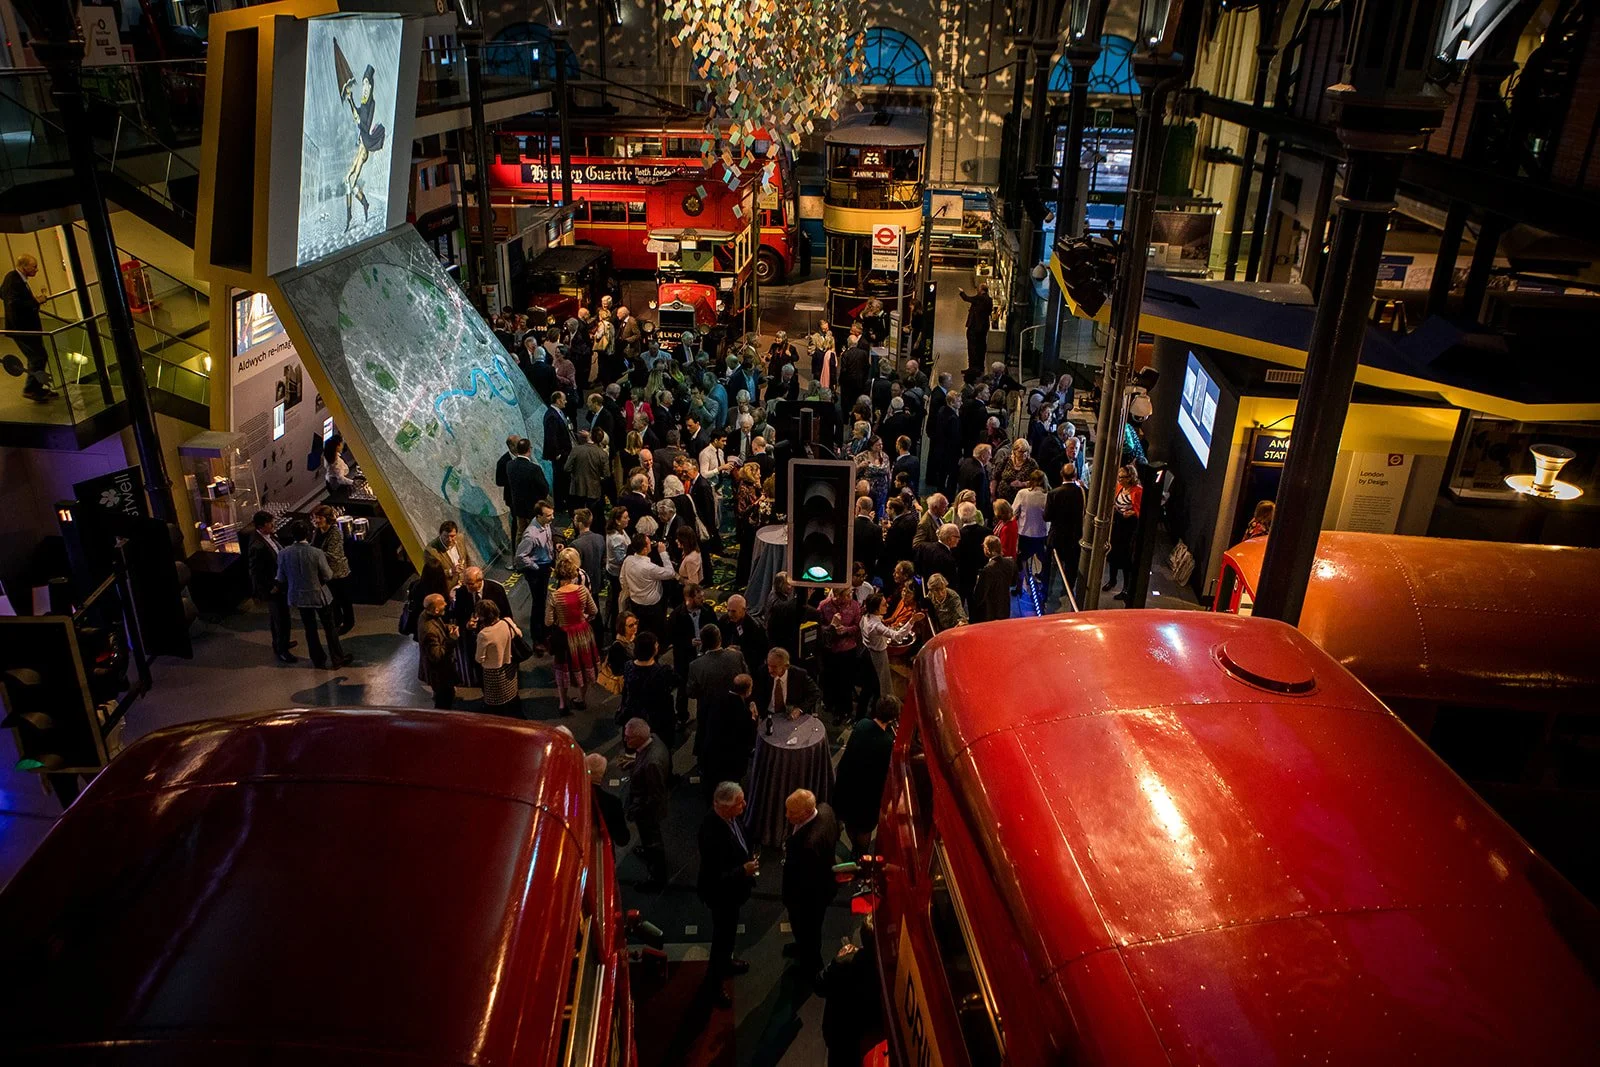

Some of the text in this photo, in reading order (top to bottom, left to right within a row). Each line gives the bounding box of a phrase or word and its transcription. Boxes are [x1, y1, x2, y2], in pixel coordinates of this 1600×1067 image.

[531, 164, 583, 184] Hackey
[585, 165, 632, 182] Gazette
[238, 340, 293, 373] Aldwych re-imag
[1155, 470, 1164, 483] 1
